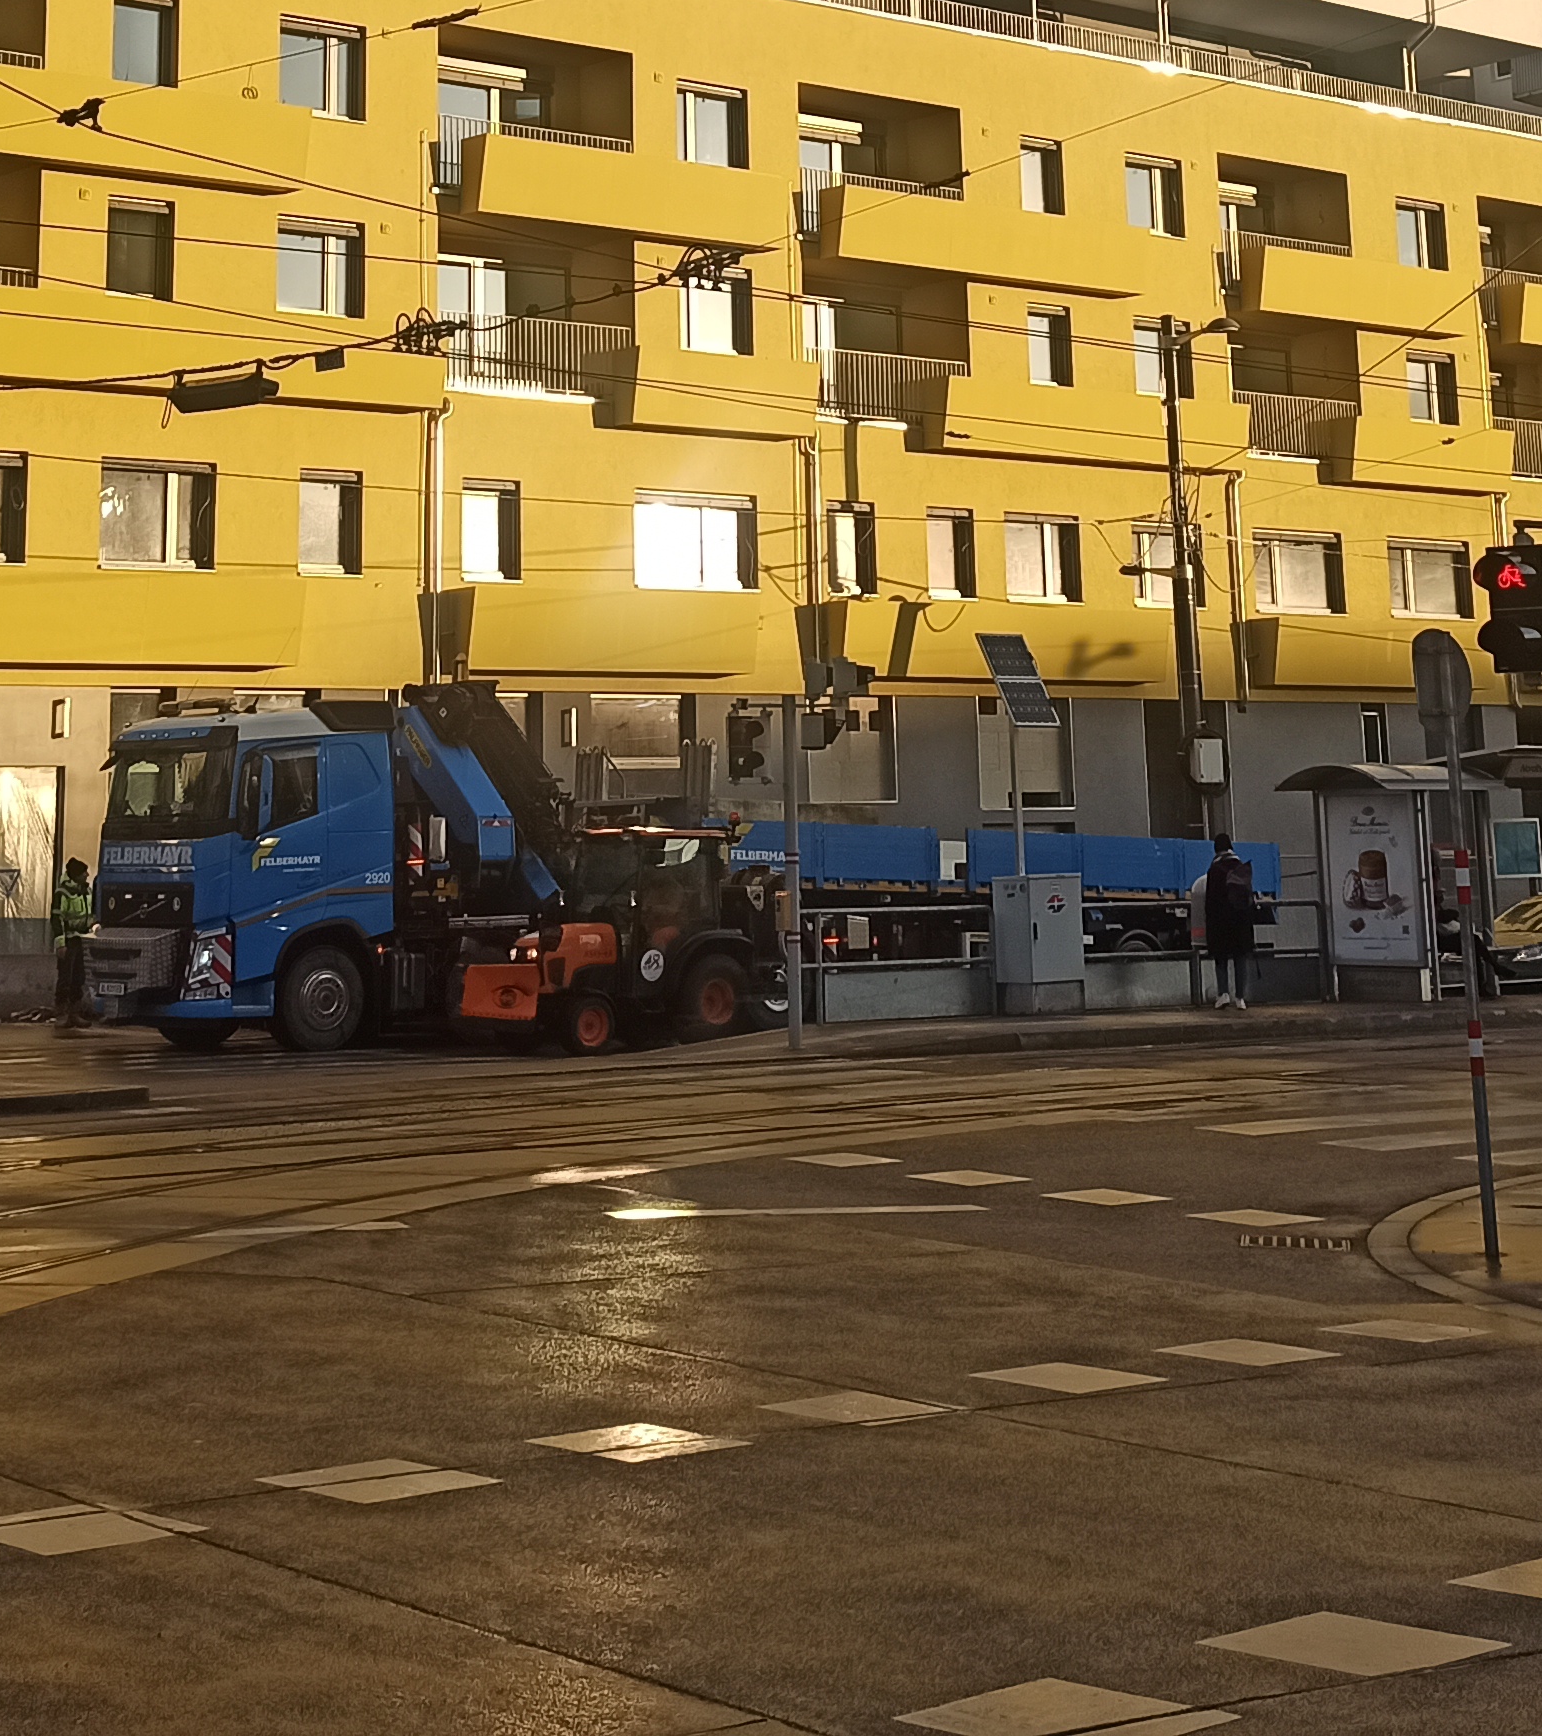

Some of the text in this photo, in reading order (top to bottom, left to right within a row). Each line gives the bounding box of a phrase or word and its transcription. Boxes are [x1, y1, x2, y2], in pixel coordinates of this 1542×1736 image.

[103, 845, 193, 866] FELBERMAYR
[260, 855, 322, 867] FELBERMAYR
[730, 849, 787, 863] FELBERMA
[365, 872, 391, 885] 2920
